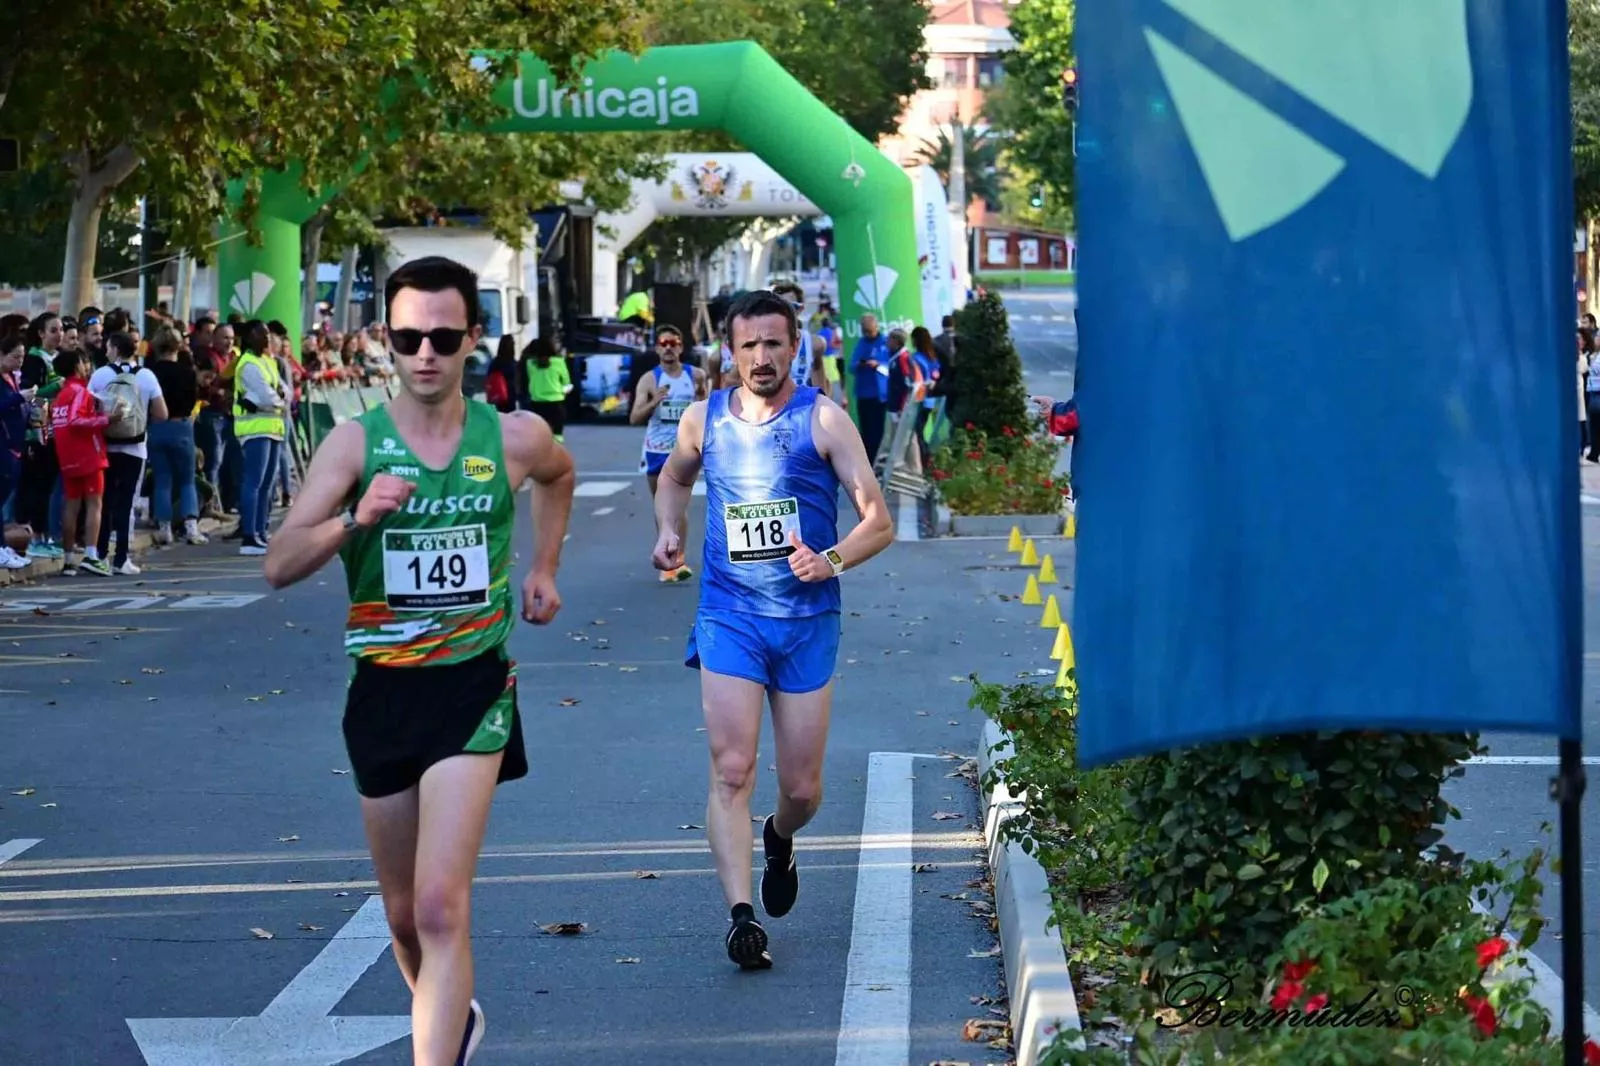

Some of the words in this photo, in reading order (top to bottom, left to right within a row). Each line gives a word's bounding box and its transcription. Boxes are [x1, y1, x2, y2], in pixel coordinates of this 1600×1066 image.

[513, 75, 699, 125] Unicaja
[398, 494, 494, 516] uesca
[741, 507, 791, 519] TOLEDO
[411, 536, 477, 551] TOLEDO
[740, 519, 785, 548] 118
[407, 553, 467, 590] 149
